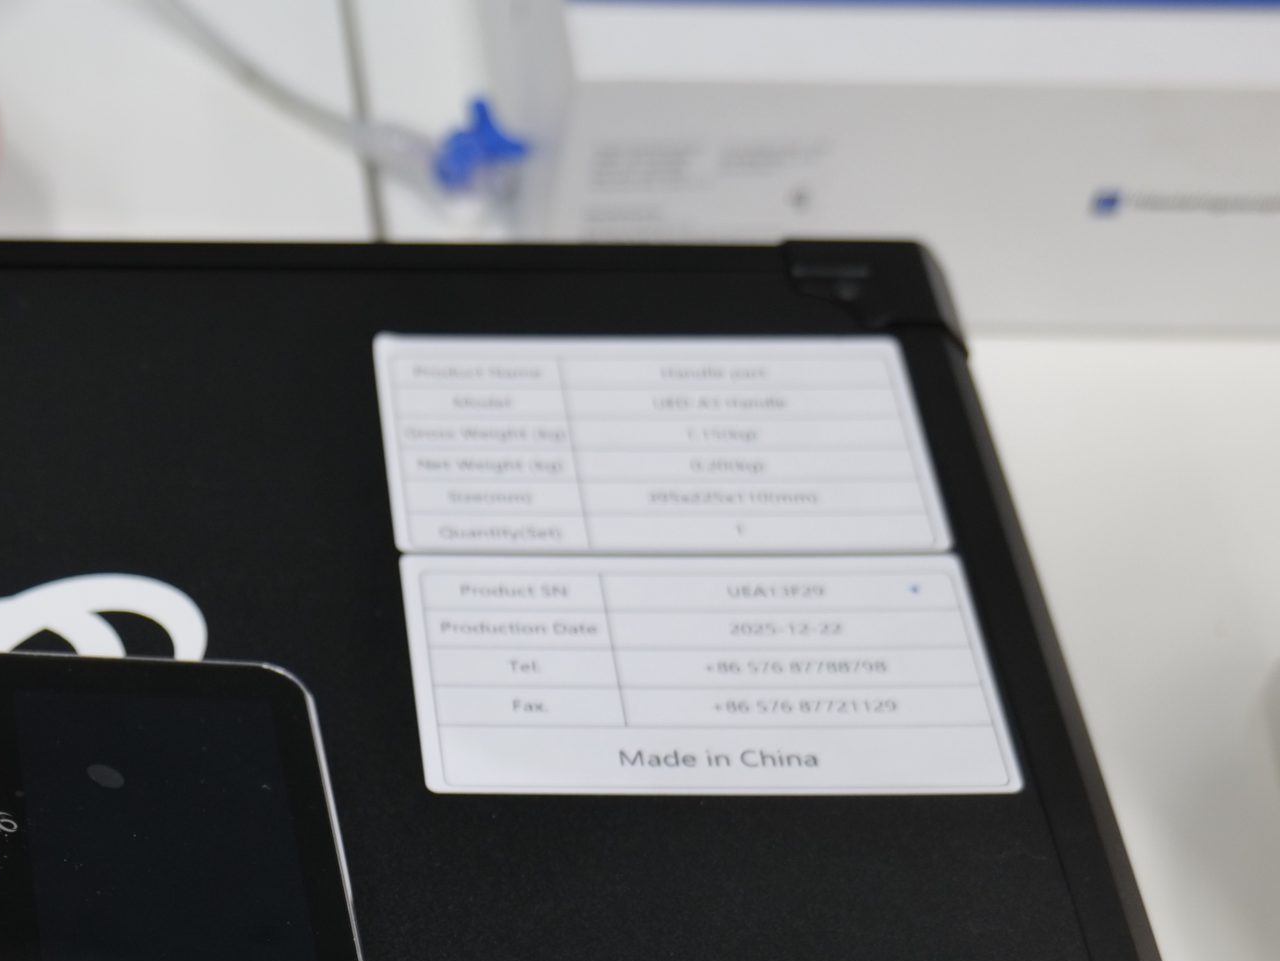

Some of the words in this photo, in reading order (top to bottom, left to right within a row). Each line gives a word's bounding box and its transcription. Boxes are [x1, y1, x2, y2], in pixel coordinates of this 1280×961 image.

[459, 584, 535, 598] Product
[541, 584, 569, 597] SN
[440, 620, 550, 636] Production
[553, 622, 599, 636] Date
[728, 621, 844, 637] 2025-12-22
[747, 660, 784, 675] 576
[756, 699, 793, 714] 576
[799, 700, 898, 715] 87721129
[619, 748, 697, 768] Made
[706, 747, 732, 768] in
[740, 748, 819, 769] China
